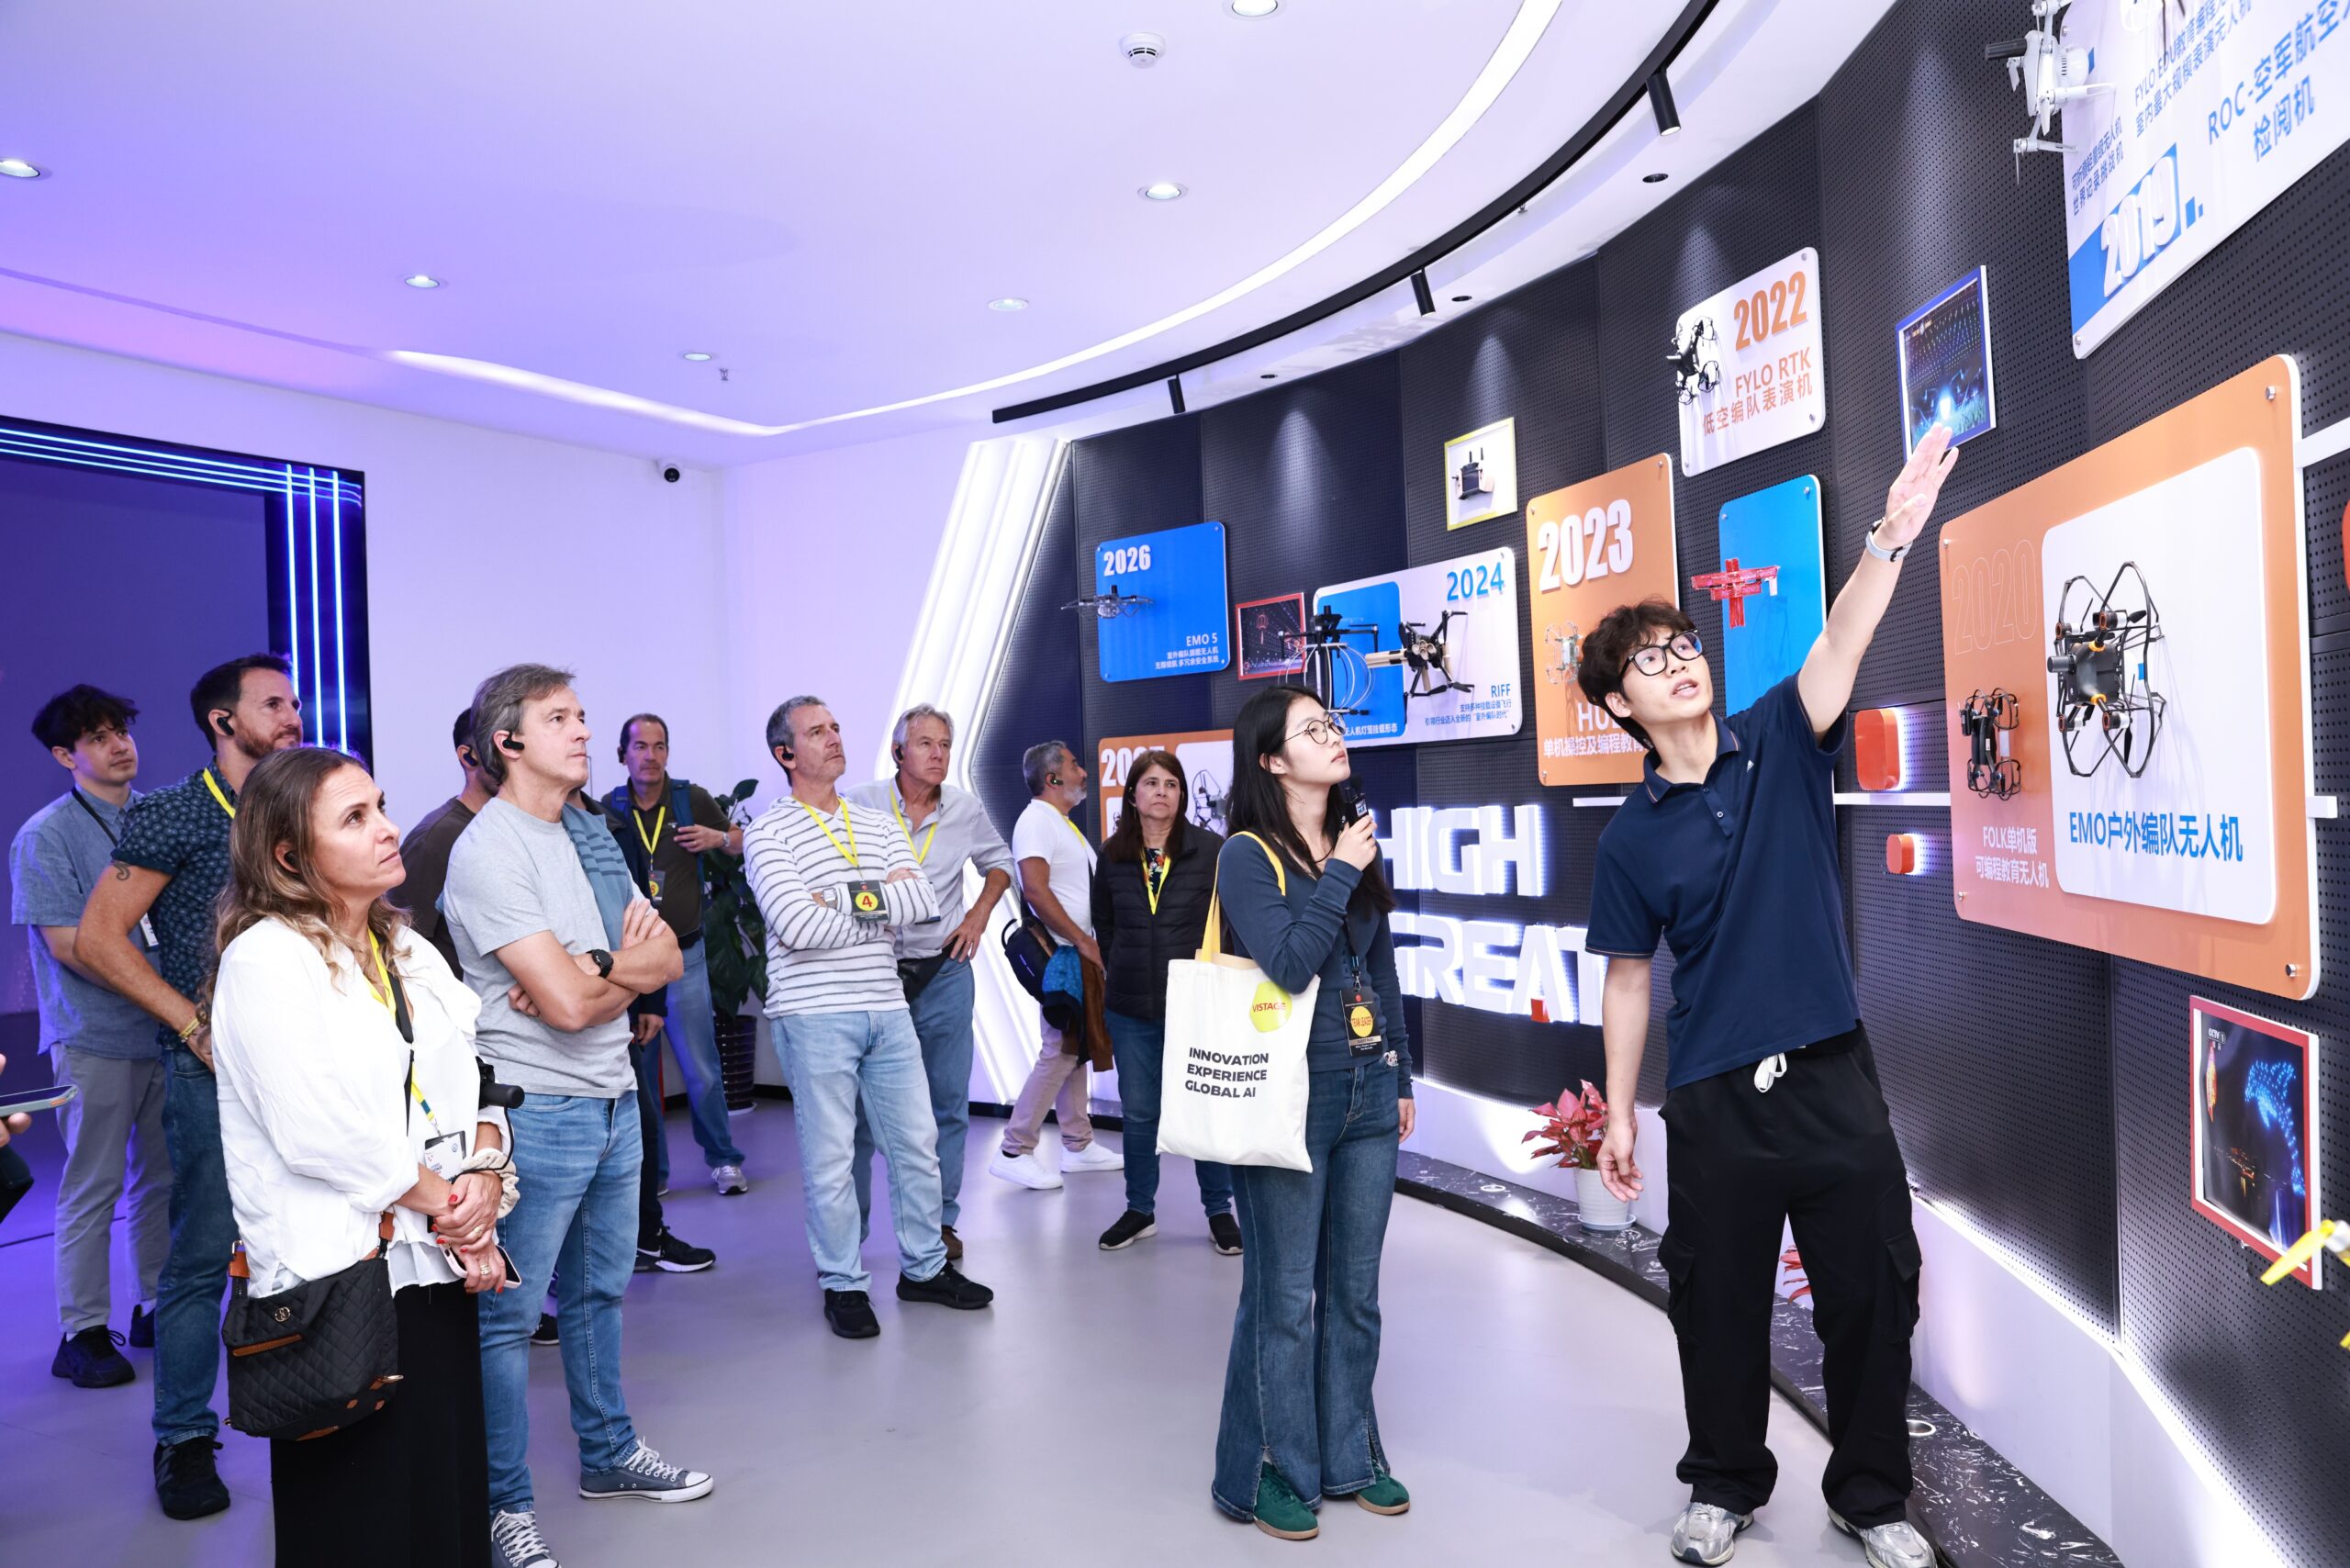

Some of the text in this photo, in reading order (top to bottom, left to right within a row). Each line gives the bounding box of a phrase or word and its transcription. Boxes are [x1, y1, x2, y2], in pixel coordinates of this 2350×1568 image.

[2135, 68, 2155, 106] FYLO
[2208, 0, 2350, 145] ROC-空军航空
[2254, 75, 2314, 162] 检阅机
[2100, 155, 2177, 297] 2019
[1734, 272, 1808, 352] 2022
[1735, 347, 1811, 398] FYLO RTK
[1703, 377, 1813, 436] 低空编队表演机
[1103, 544, 1151, 577] 2026
[1538, 499, 1633, 592] 2023
[1447, 563, 1505, 602] 2024
[1953, 540, 2038, 655] 2020
[1186, 633, 1218, 647] EMO 5
[1491, 683, 1512, 698] RIFF
[1544, 733, 1649, 758] 单机操控及编程教育
[1983, 825, 2037, 855] FOLK单机版
[2069, 811, 2244, 862] EMO户外编队无人机
[1975, 855, 2050, 889] 可编程教育无人机
[862, 895, 873, 907] 4
[1252, 1002, 1286, 1014] VISTAGE
[1187, 1063, 1268, 1081] EXPERIENCE
[1189, 1047, 1270, 1066] INNOVATION
[1185, 1080, 1256, 1098] GLOBAL AI
